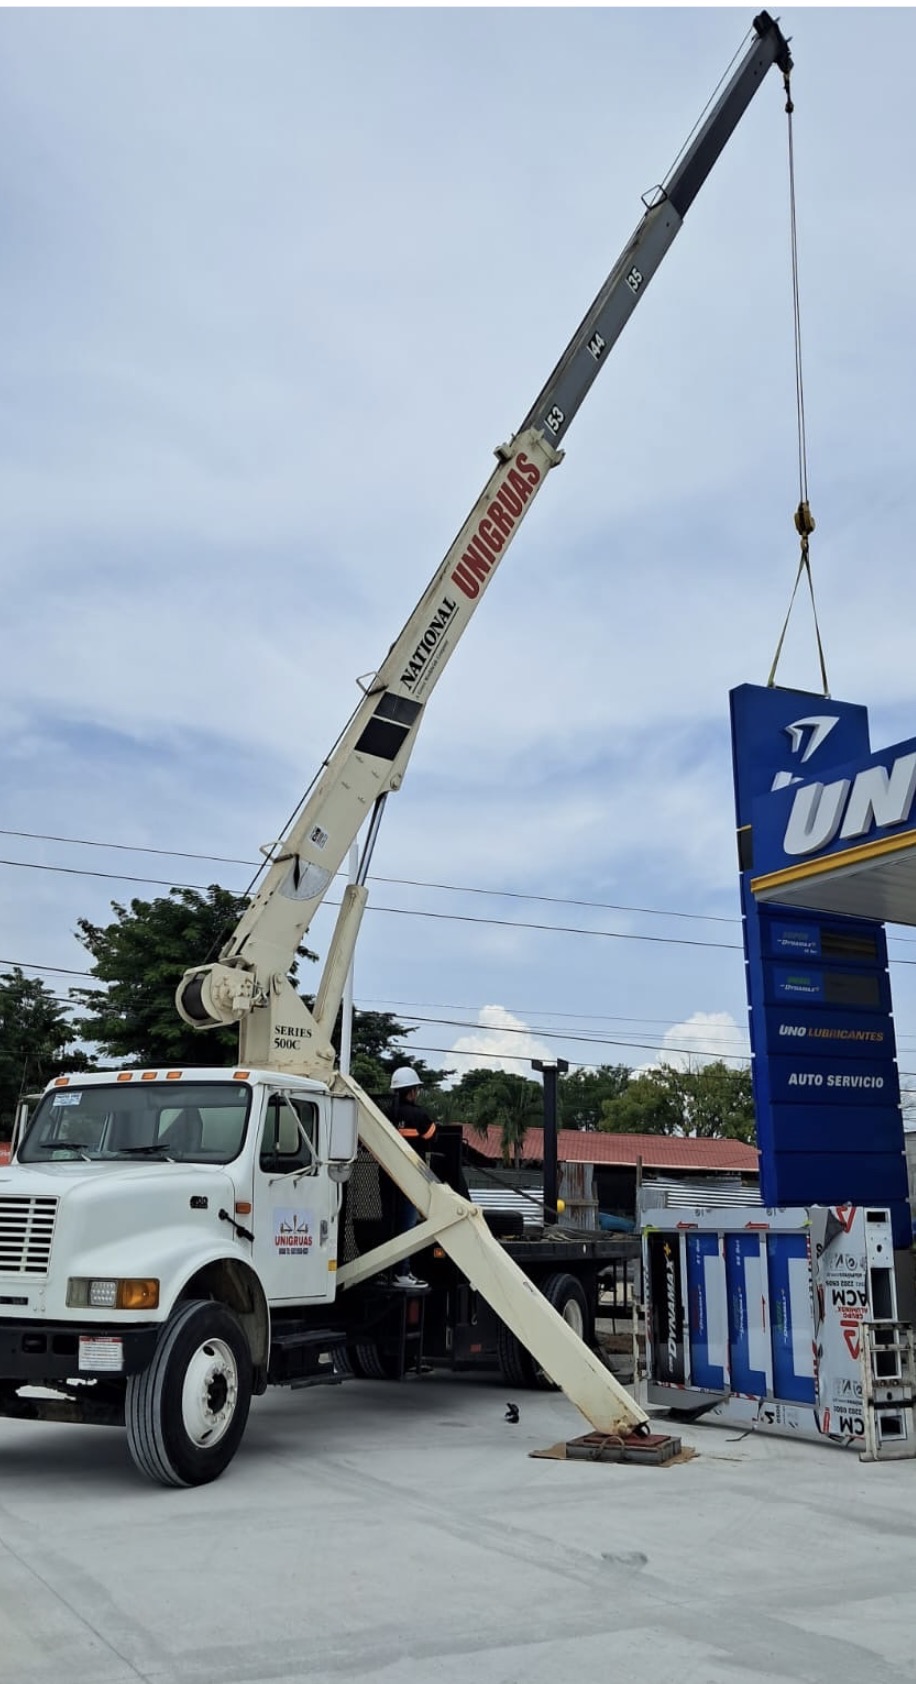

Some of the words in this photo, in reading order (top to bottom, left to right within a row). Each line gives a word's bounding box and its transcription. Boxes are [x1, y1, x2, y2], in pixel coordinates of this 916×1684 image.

[627, 267, 643, 291] 35
[589, 332, 606, 357] 44
[546, 406, 565, 432] 53
[450, 452, 541, 600] UNIGRUAS
[400, 596, 456, 691] NATIONAL
[274, 1024, 312, 1039] SERIES
[779, 1024, 807, 1037] UNO
[808, 1026, 884, 1042] LUBRICANTES
[274, 1037, 301, 1051] 500C
[788, 1072, 823, 1087] AUTO
[827, 1075, 884, 1089] SERVICIO
[275, 1236, 313, 1246] UNIGRUAS
[832, 1289, 867, 1307] ACM
[839, 1416, 865, 1436] CM
